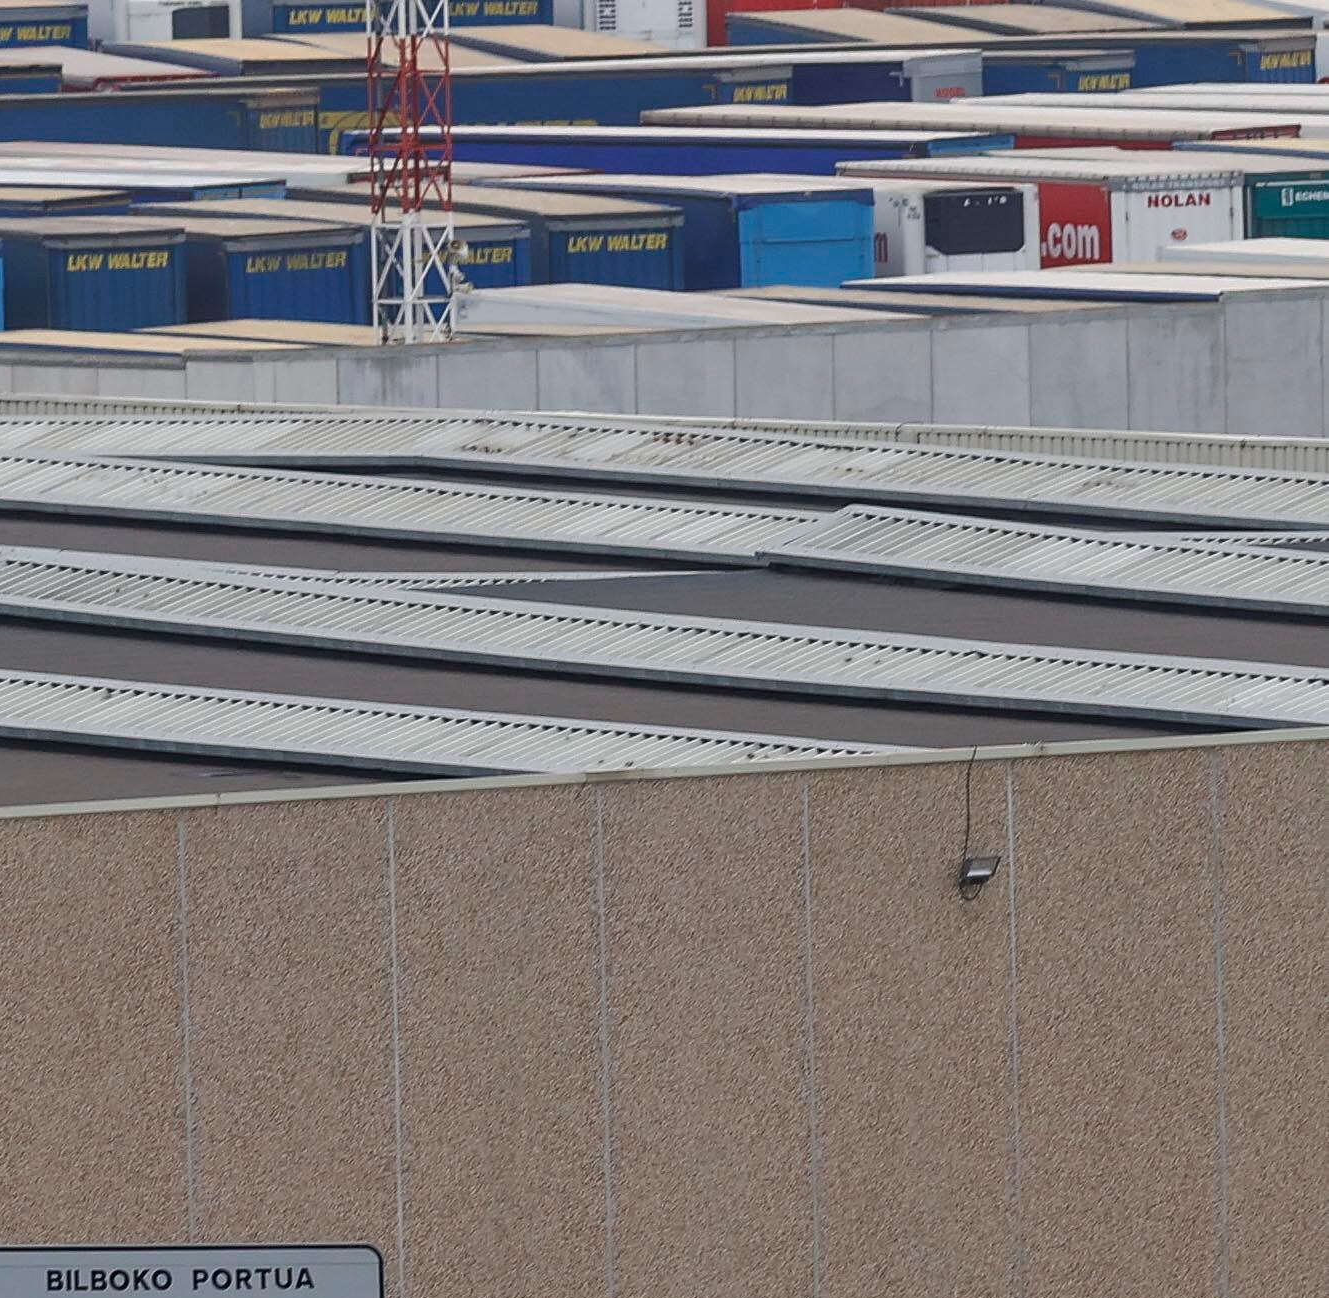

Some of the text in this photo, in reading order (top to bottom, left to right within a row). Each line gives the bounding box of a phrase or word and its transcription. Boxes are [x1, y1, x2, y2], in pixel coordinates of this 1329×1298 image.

[1147, 192, 1212, 209] NOLAN
[568, 233, 669, 253] LKW WALTER
[67, 251, 169, 273] LKW WALTER
[246, 251, 346, 273] LKW WALTER
[46, 1267, 315, 1292] BILBOKO PORTUA
